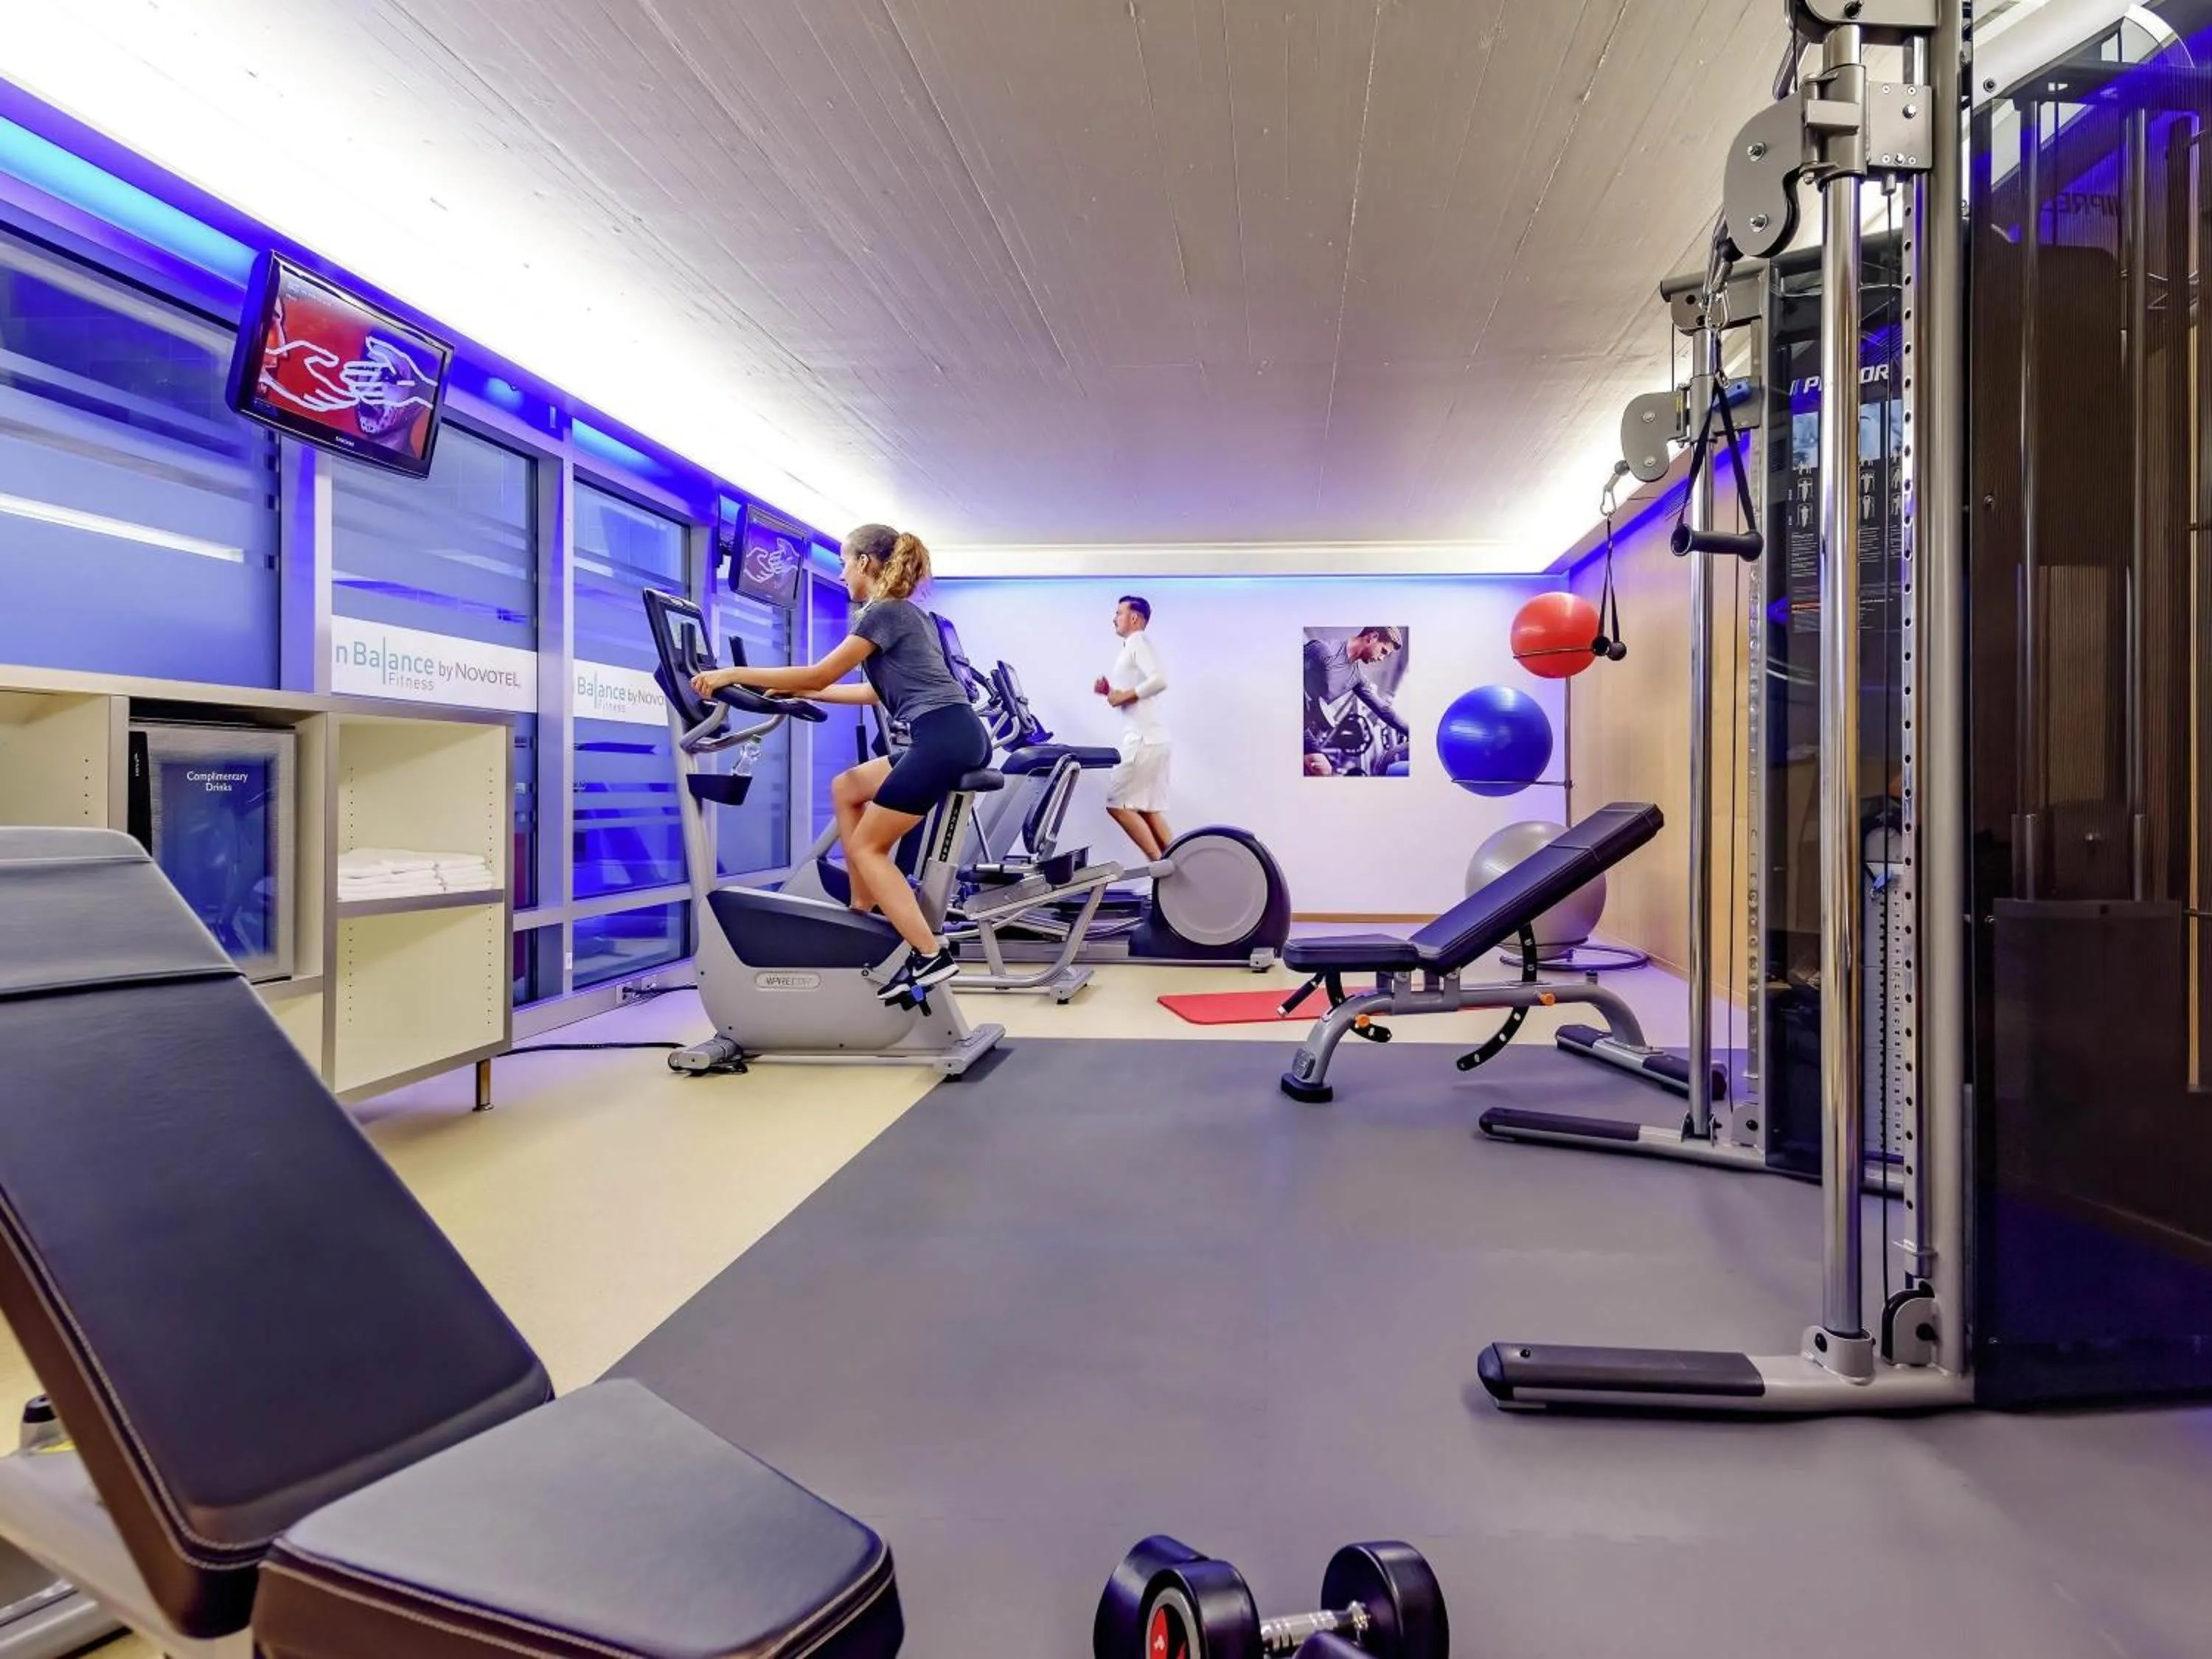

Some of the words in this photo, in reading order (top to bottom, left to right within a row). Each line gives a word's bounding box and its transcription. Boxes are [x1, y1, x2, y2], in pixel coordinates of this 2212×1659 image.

[354, 636, 434, 684] Balance
[439, 661, 453, 681] by
[456, 662, 521, 686] NOVOTEL
[389, 672, 434, 691] Fitness
[577, 672, 625, 709] Balance
[187, 771, 248, 783] Complimentary
[206, 782, 232, 791] Drinks
